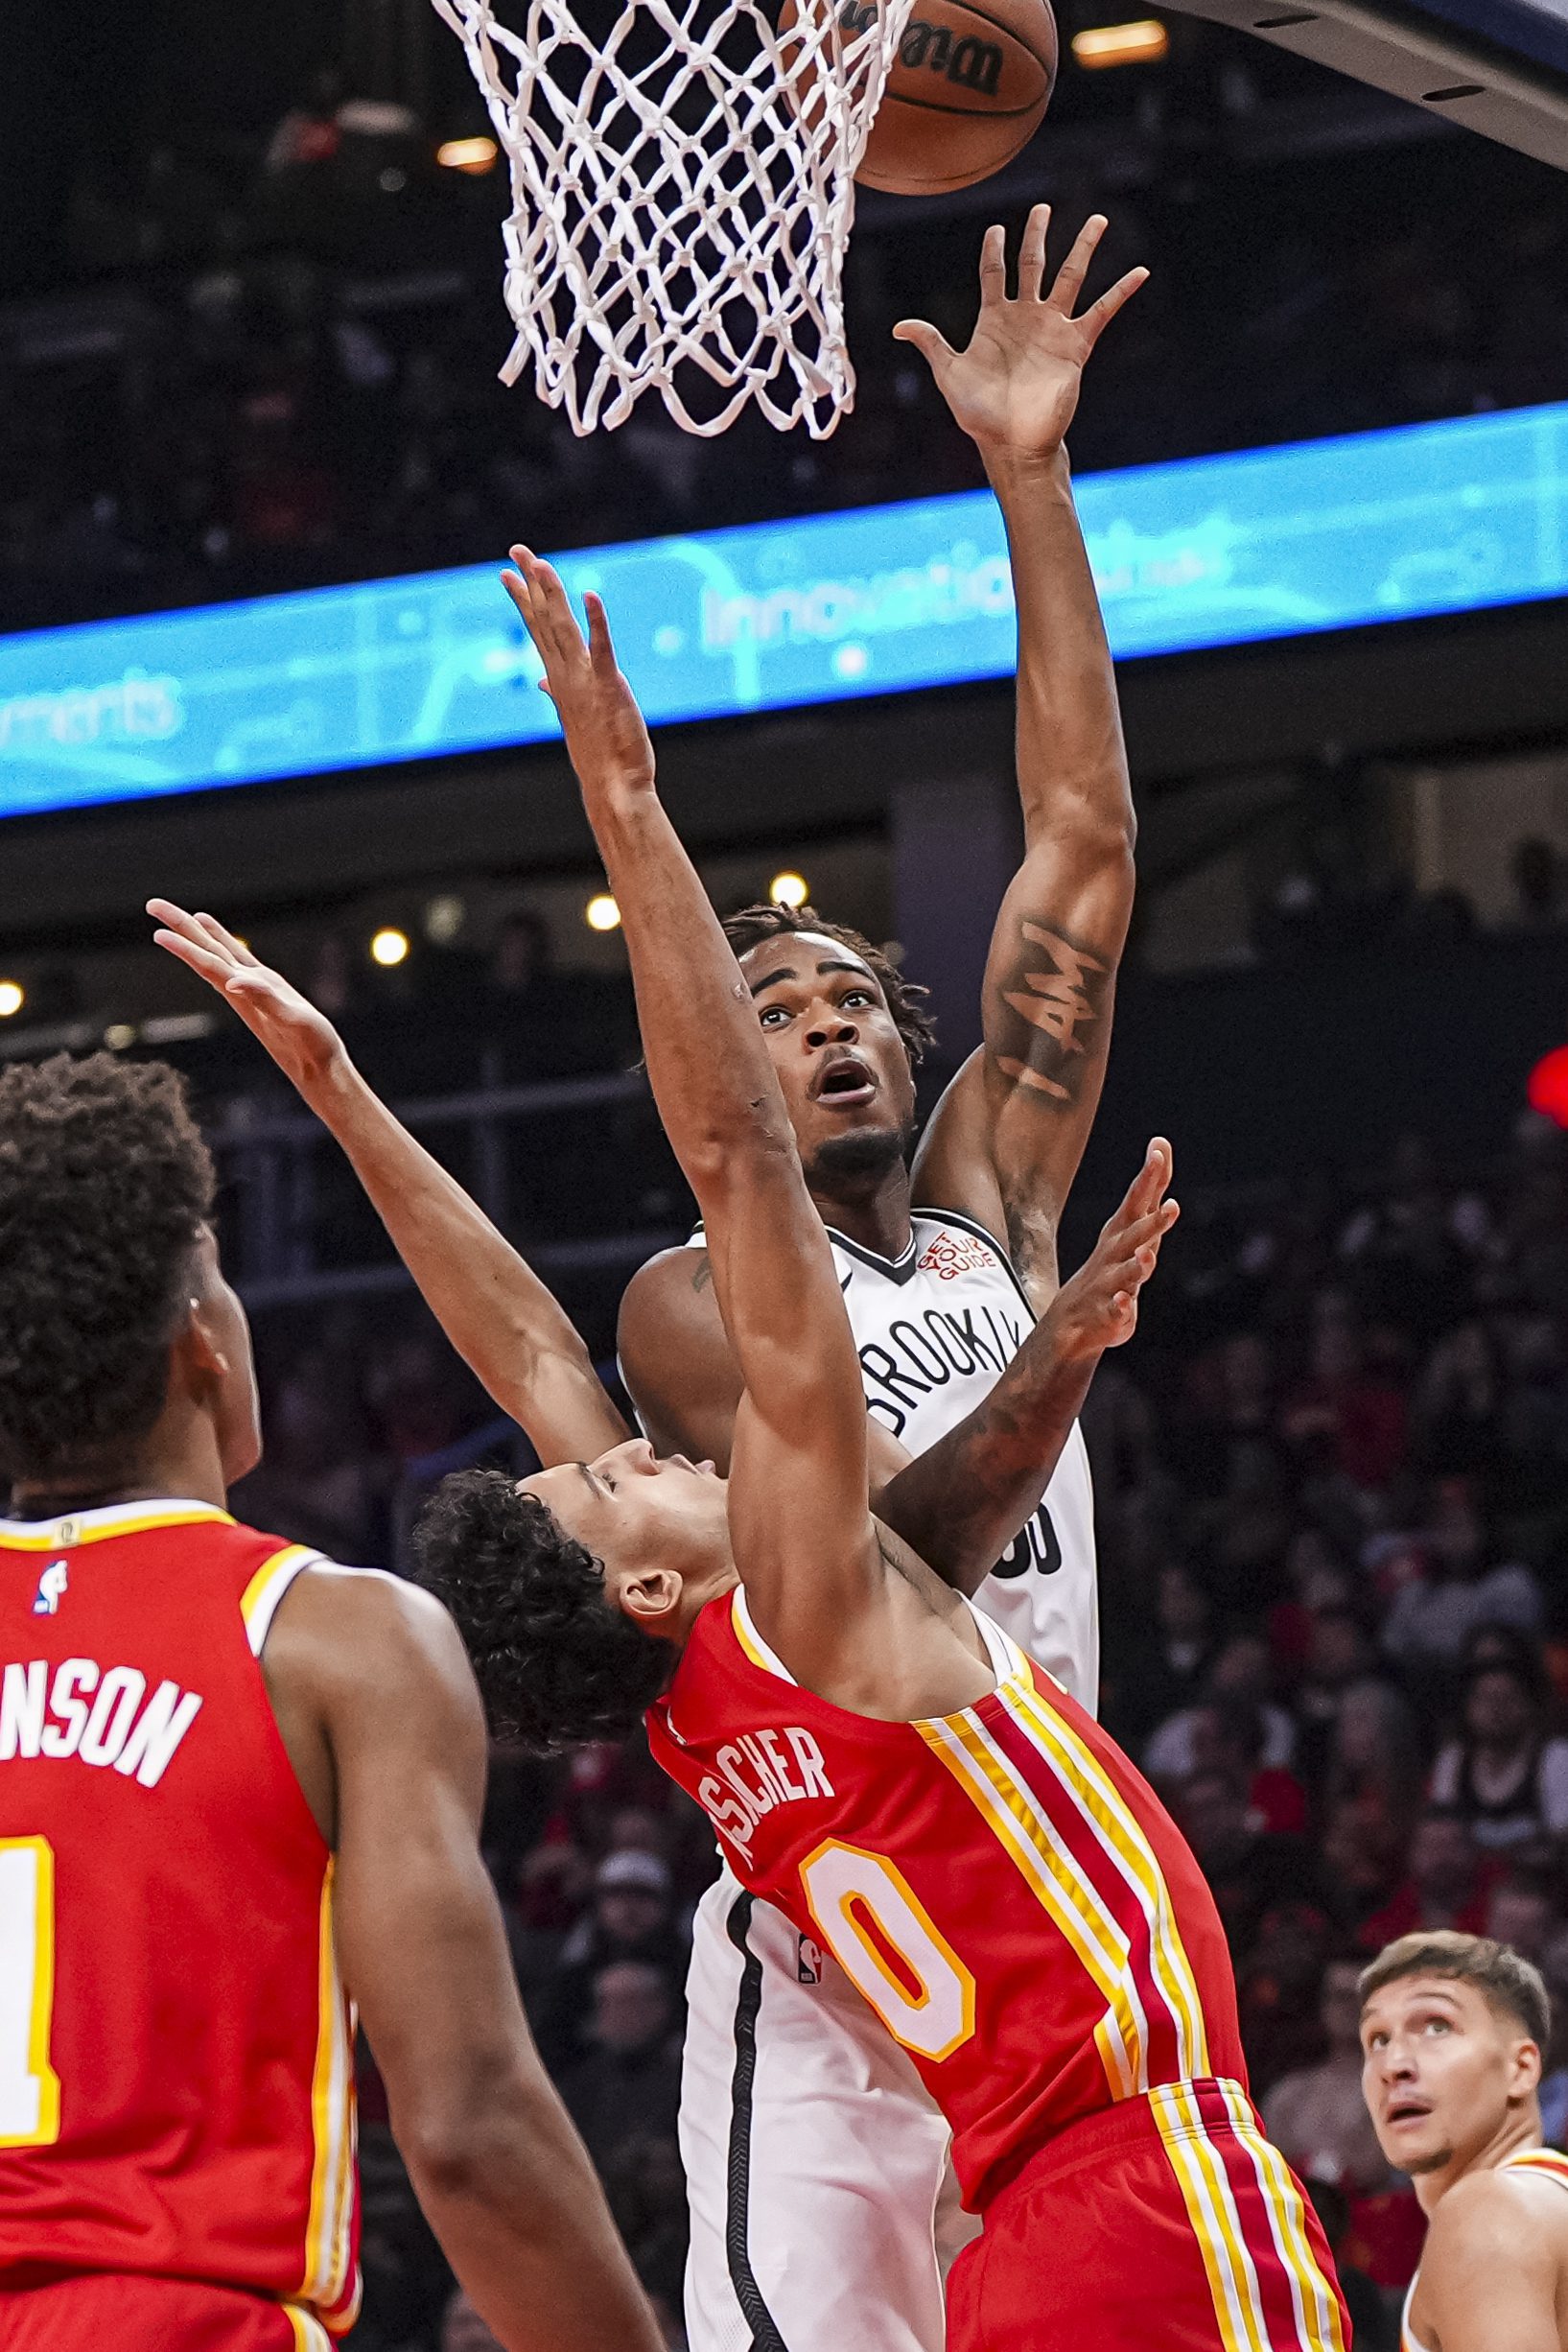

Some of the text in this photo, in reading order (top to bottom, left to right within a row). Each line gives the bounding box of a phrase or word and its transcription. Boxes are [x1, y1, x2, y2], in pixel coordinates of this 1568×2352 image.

[841, 0, 1003, 96] Wilon
[917, 1232, 951, 1269] GET
[925, 1237, 983, 1272] YOUR
[939, 1252, 996, 1280] GUIDE
[798, 1837, 975, 2063] 0
